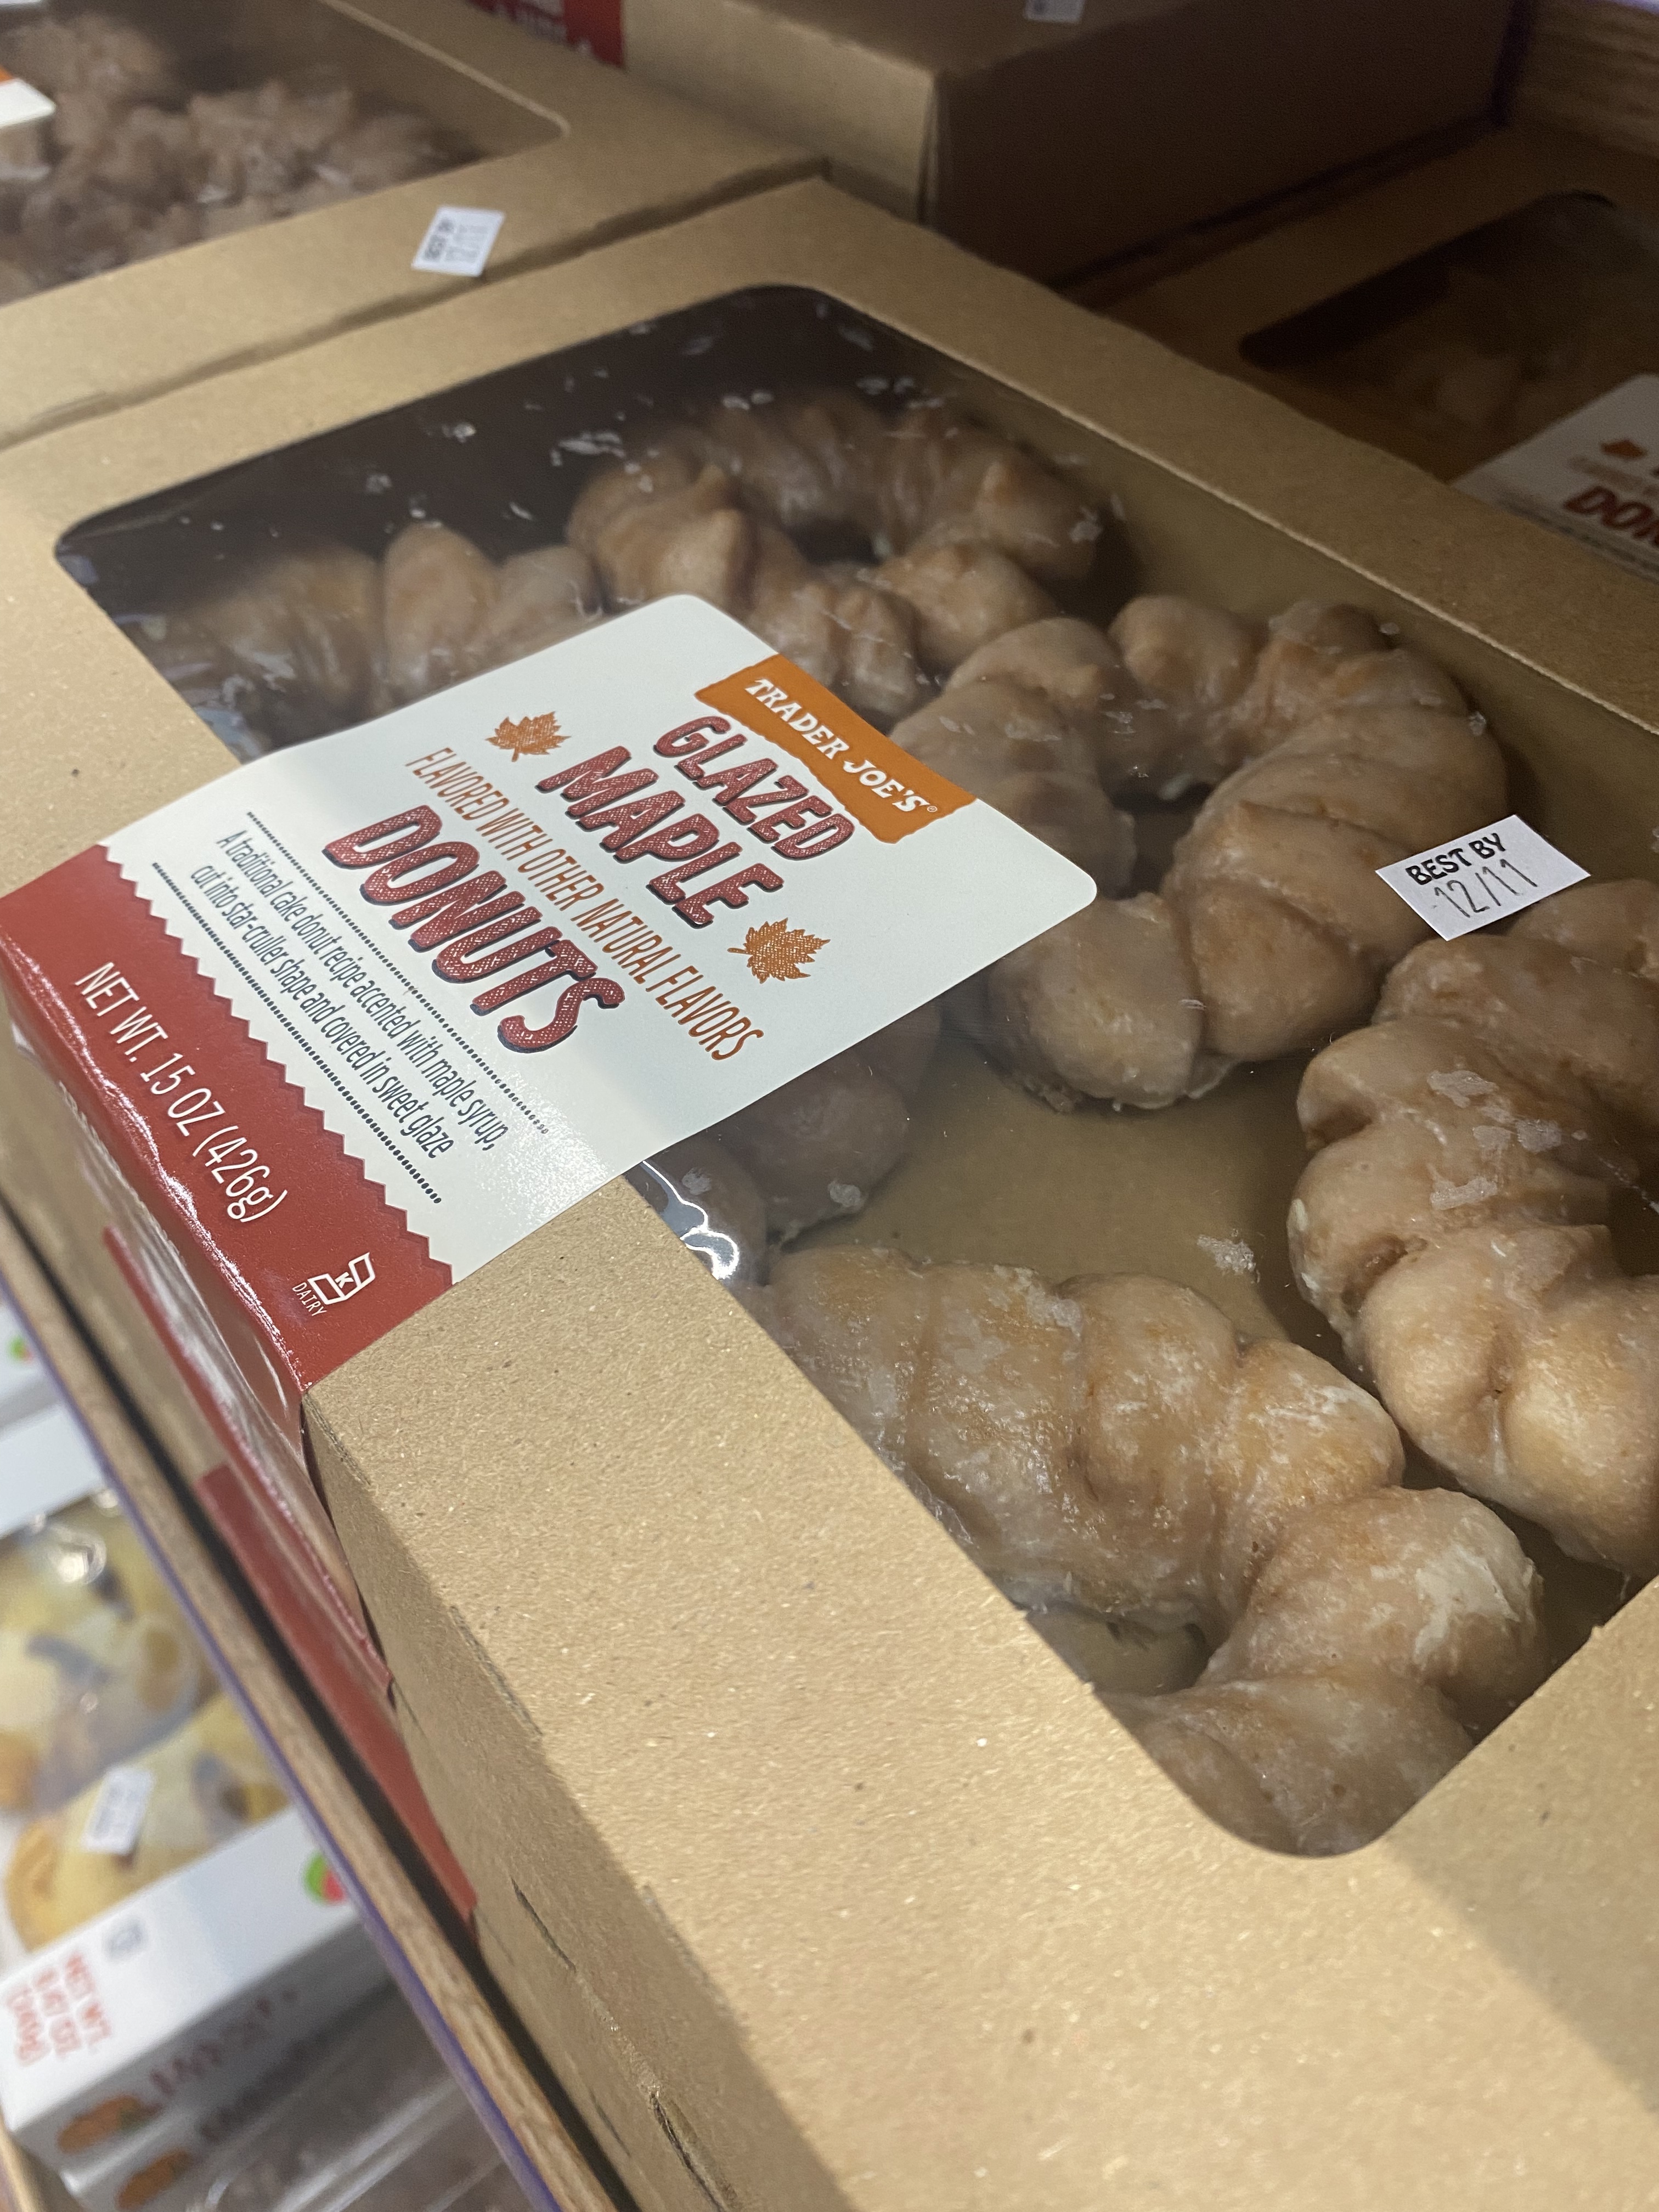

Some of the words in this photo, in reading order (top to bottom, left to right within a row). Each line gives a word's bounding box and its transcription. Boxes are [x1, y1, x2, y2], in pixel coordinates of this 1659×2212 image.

[744, 678, 850, 759] TRADER
[653, 716, 855, 860] GLAZED
[216, 830, 247, 848] A
[535, 745, 784, 929] MAPLE
[1405, 848, 1471, 885] BEST
[1468, 833, 1506, 859] BY
[191, 865, 226, 889] cut
[204, 876, 239, 909] into
[225, 838, 294, 898] traditional
[1434, 859, 1538, 918] 12/11
[270, 891, 308, 922] cake
[405, 747, 510, 821] FLAVORED
[475, 808, 553, 861] WITH
[517, 848, 605, 911] OTHER
[570, 898, 681, 984] NATURAL
[645, 966, 764, 1060] FLAVORS
[221, 902, 290, 966] star-cruller
[291, 914, 342, 955] donut
[323, 804, 625, 1054] DONUTS
[75, 962, 140, 1017] NET
[270, 959, 317, 1001] shape
[319, 946, 367, 988] recipe
[300, 992, 346, 1024] and
[350, 980, 421, 1039] accented
[110, 1006, 168, 1062] WT.
[320, 1017, 386, 1070] covered
[397, 1030, 443, 1068] with
[140, 1053, 196, 1095] 15
[359, 1057, 392, 1085] in
[421, 1058, 477, 1107] maple
[167, 1087, 226, 1137] OZ
[372, 1076, 430, 1124] sweet
[458, 1099, 509, 1151] syrup,
[400, 1115, 454, 1159] glaze
[192, 1125, 287, 1223] (426g)
[292, 1282, 327, 1316] DAIRY
